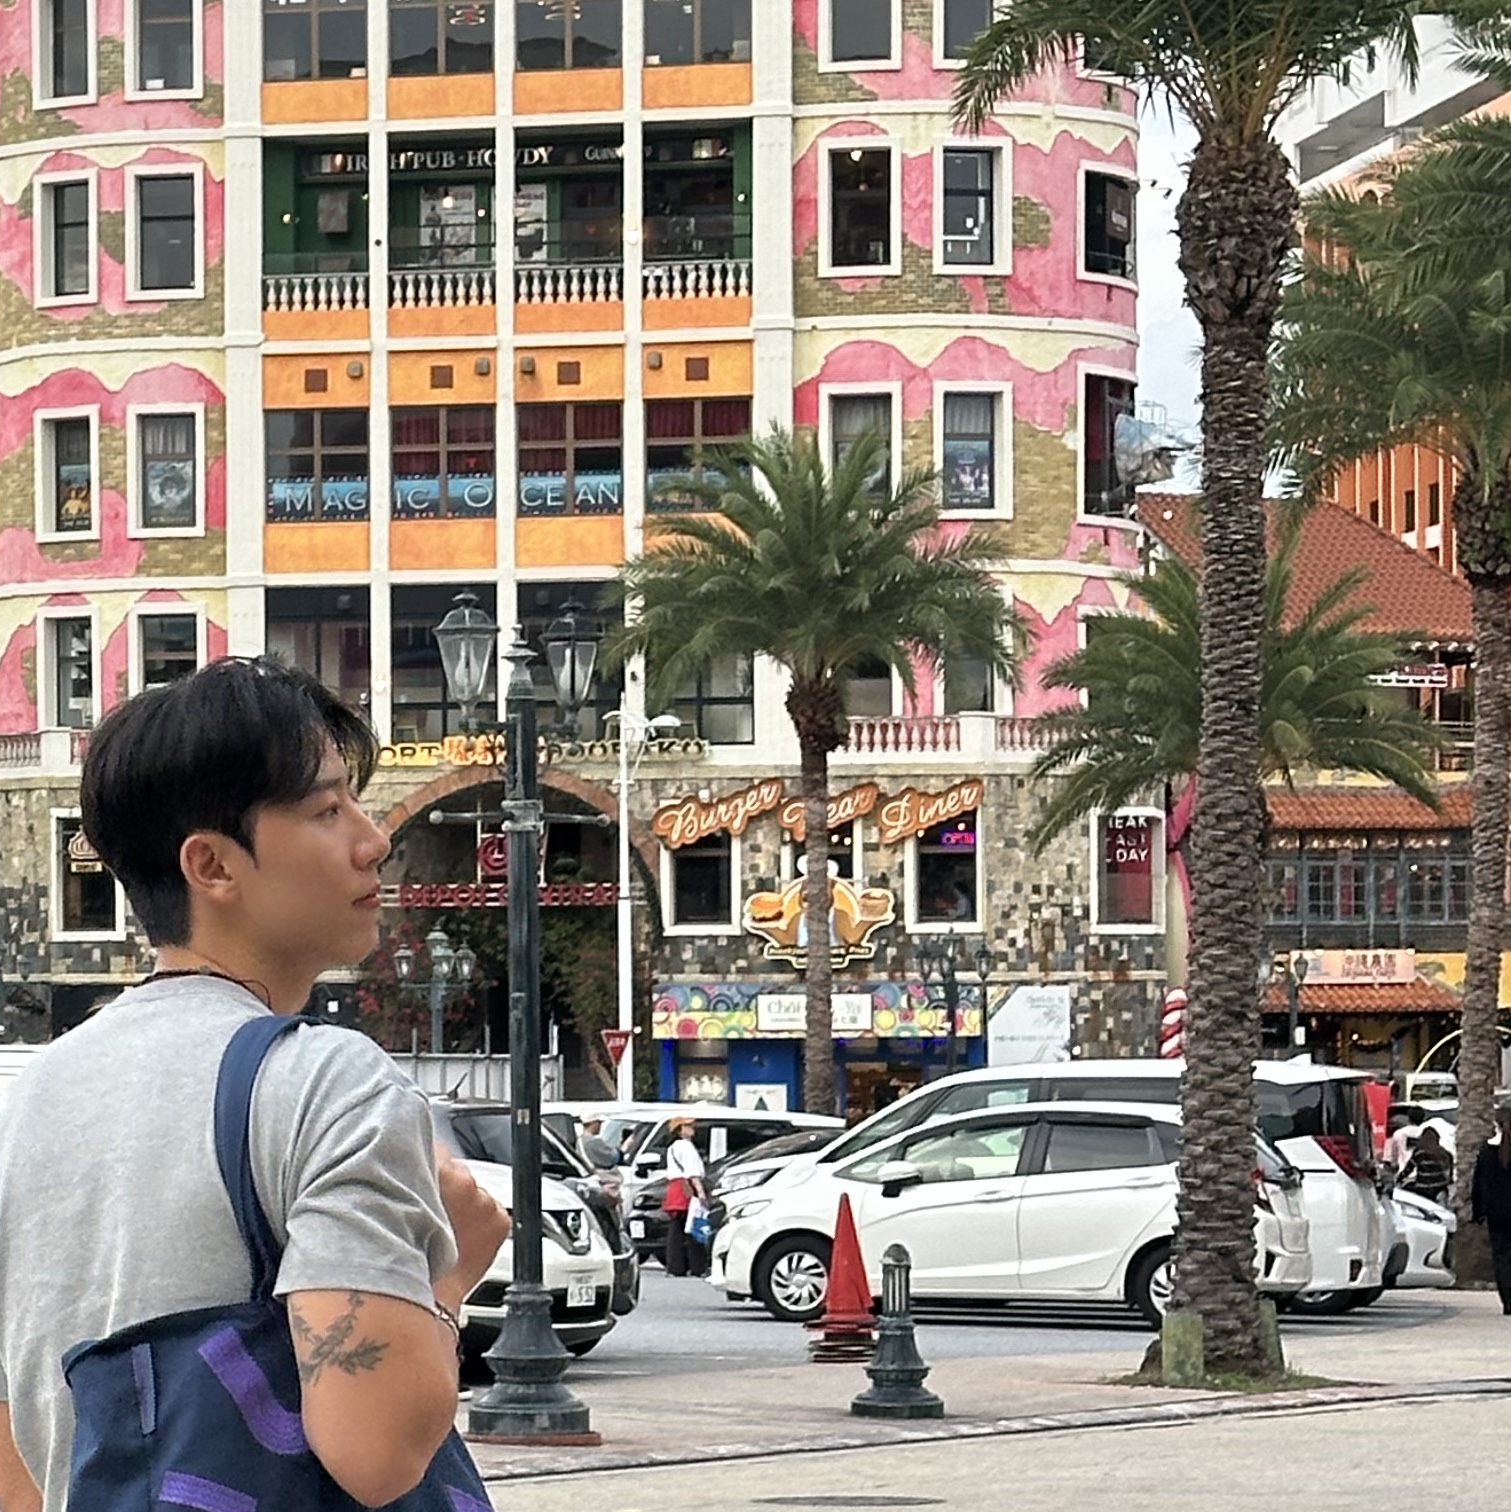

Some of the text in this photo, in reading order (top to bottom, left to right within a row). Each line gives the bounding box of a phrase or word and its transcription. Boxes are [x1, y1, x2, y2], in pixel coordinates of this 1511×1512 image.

[346, 145, 554, 171] IRH PUB HODY
[462, 481, 620, 508] OCEAN
[657, 783, 779, 839] Burger
[880, 784, 980, 838] Diner
[1116, 848, 1149, 863] DAY
